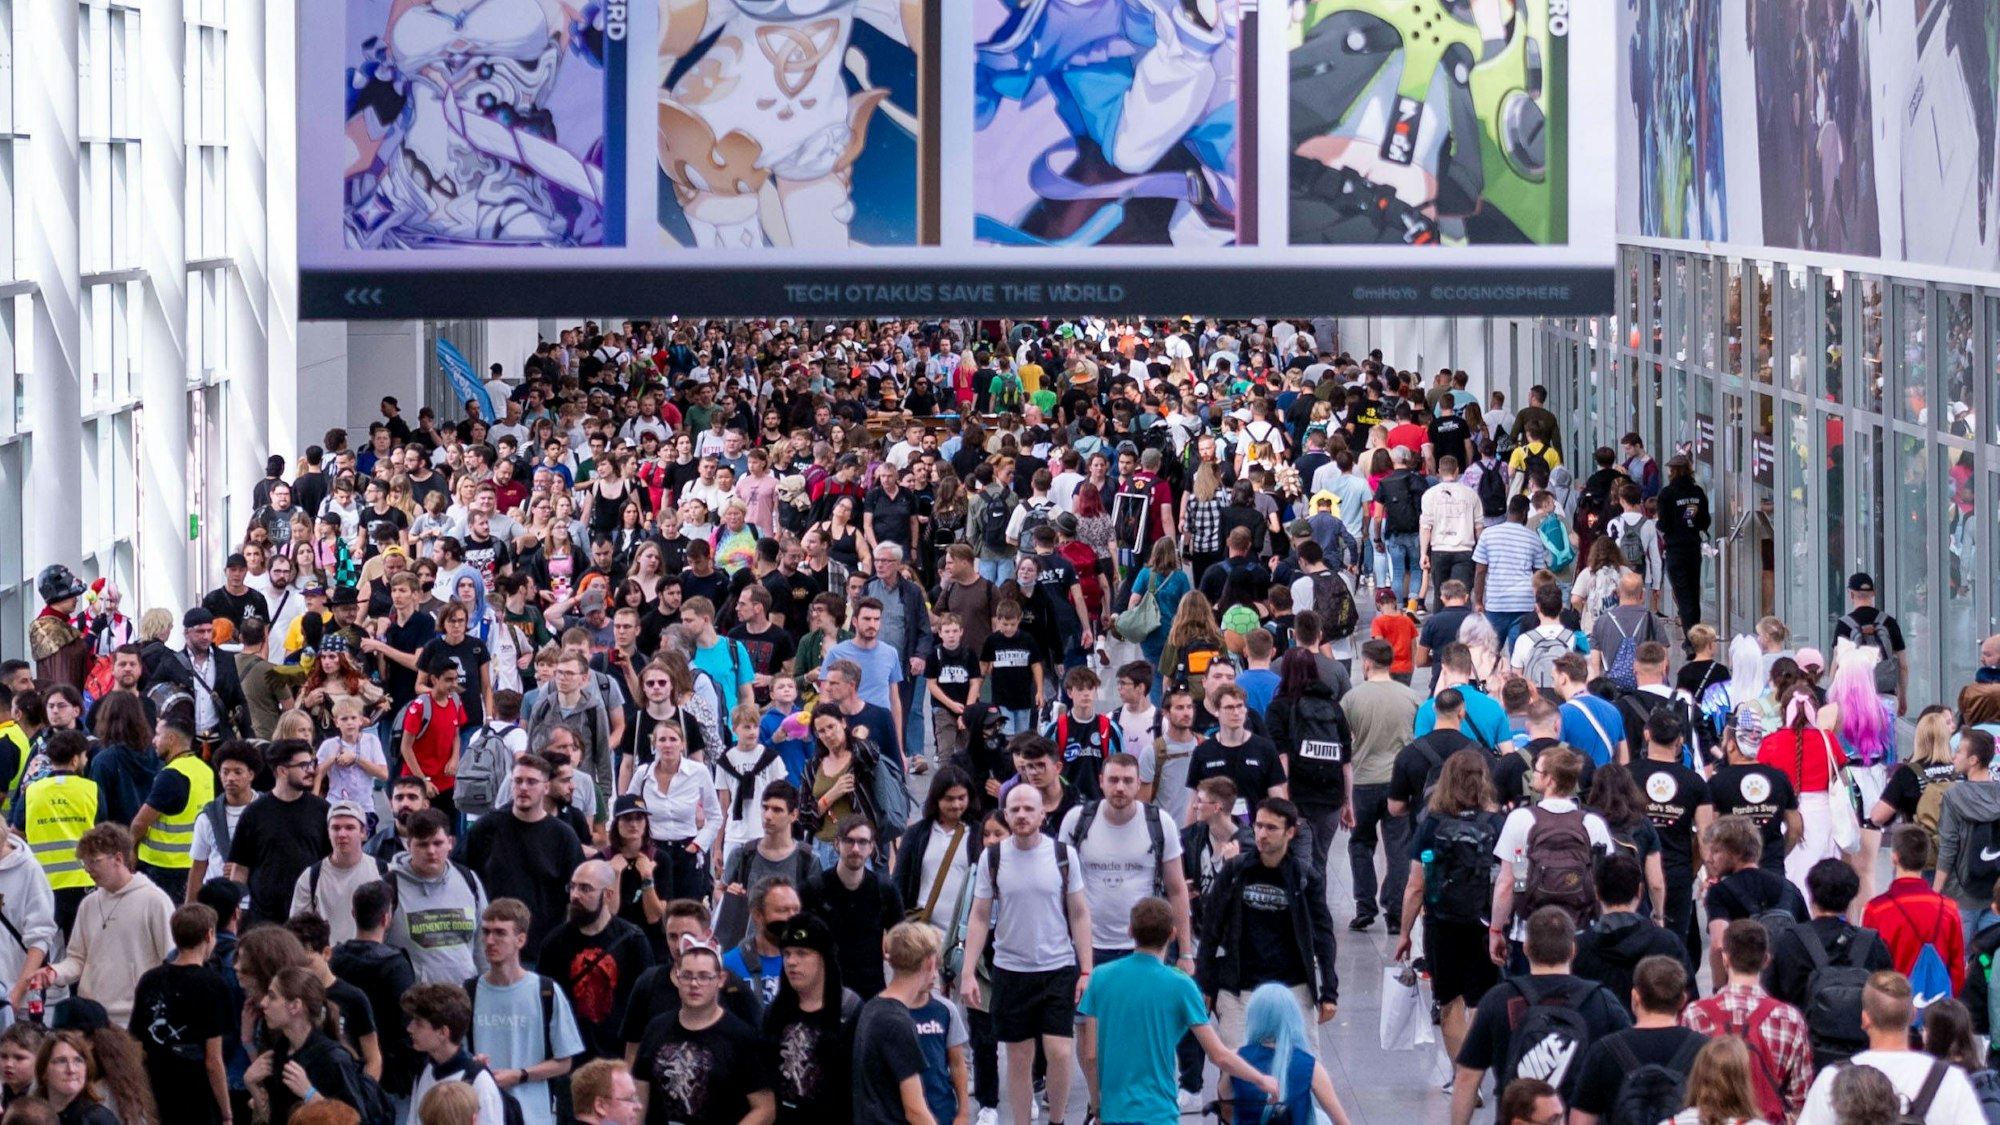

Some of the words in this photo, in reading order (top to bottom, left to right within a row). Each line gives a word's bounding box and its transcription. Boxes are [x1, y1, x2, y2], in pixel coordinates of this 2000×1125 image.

[607, 0, 626, 40] RD
[784, 284, 839, 302] TECH
[845, 284, 933, 302] OTAKUS
[938, 284, 994, 302] SAVE
[1000, 284, 1042, 302] THE
[1048, 284, 1125, 302] WORLD
[411, 920, 451, 934] AUTHENTIC
